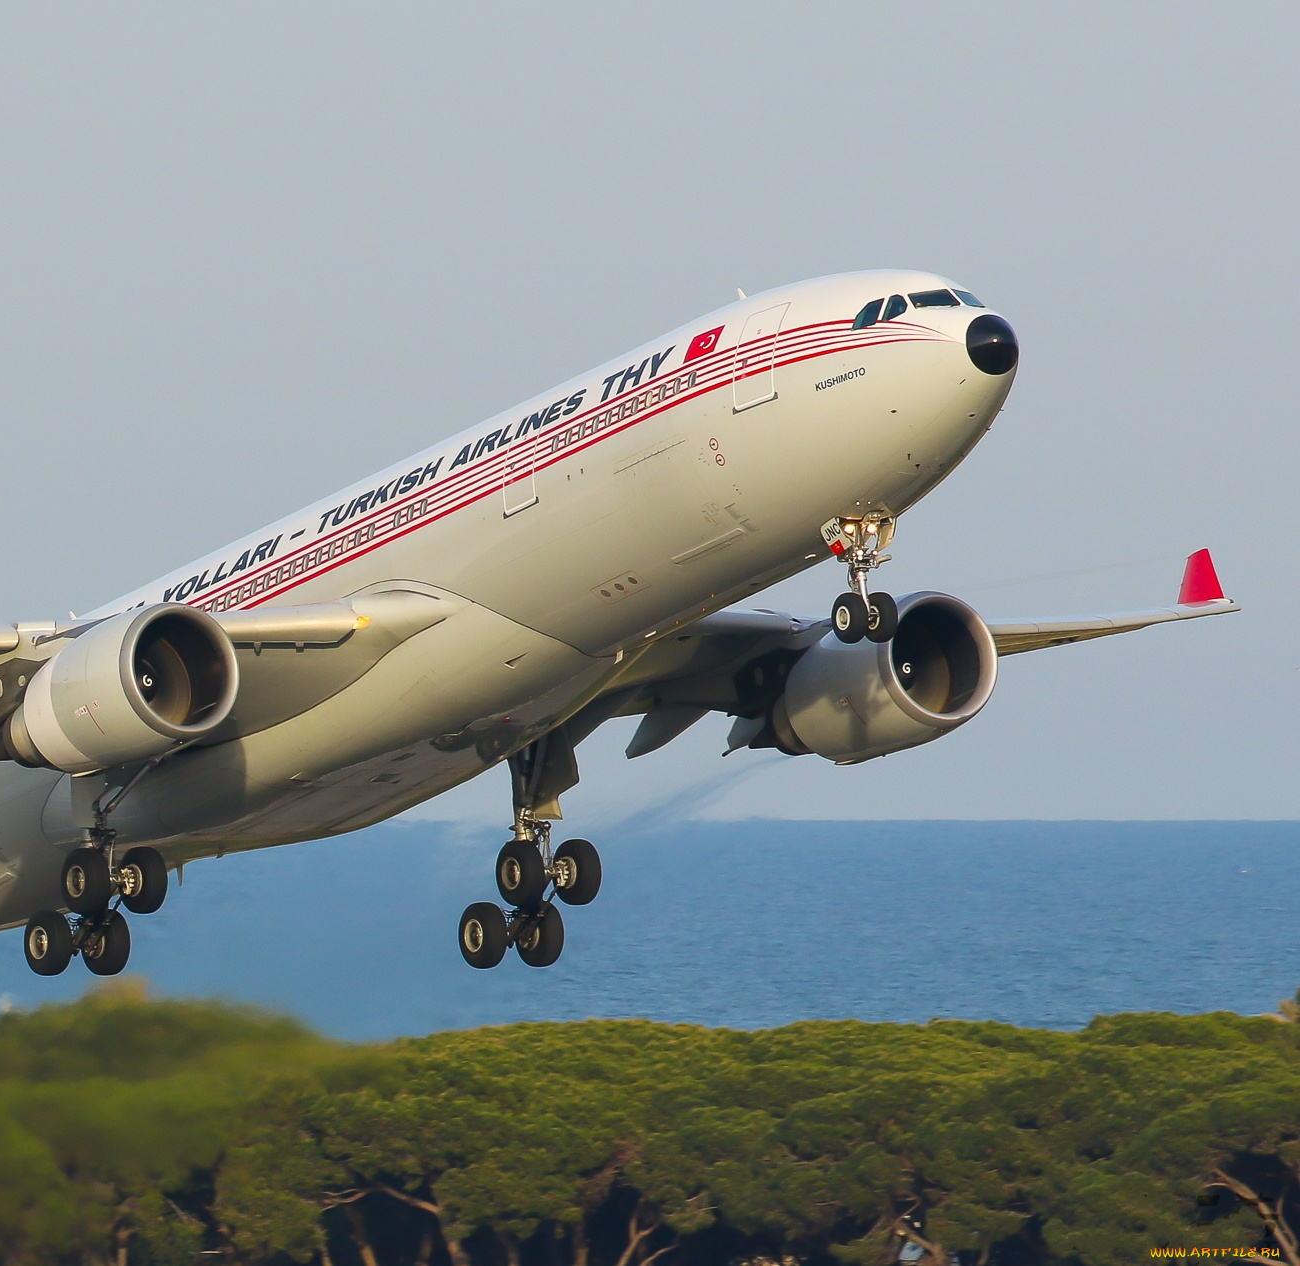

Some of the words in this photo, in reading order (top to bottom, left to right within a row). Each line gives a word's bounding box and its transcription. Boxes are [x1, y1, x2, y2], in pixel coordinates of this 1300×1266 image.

[815, 367, 866, 391] KUSHIMOTO
[317, 456, 445, 534] TURKISH
[448, 388, 587, 472] AIRLINES
[600, 345, 676, 403] THY
[824, 523, 841, 542] JNC
